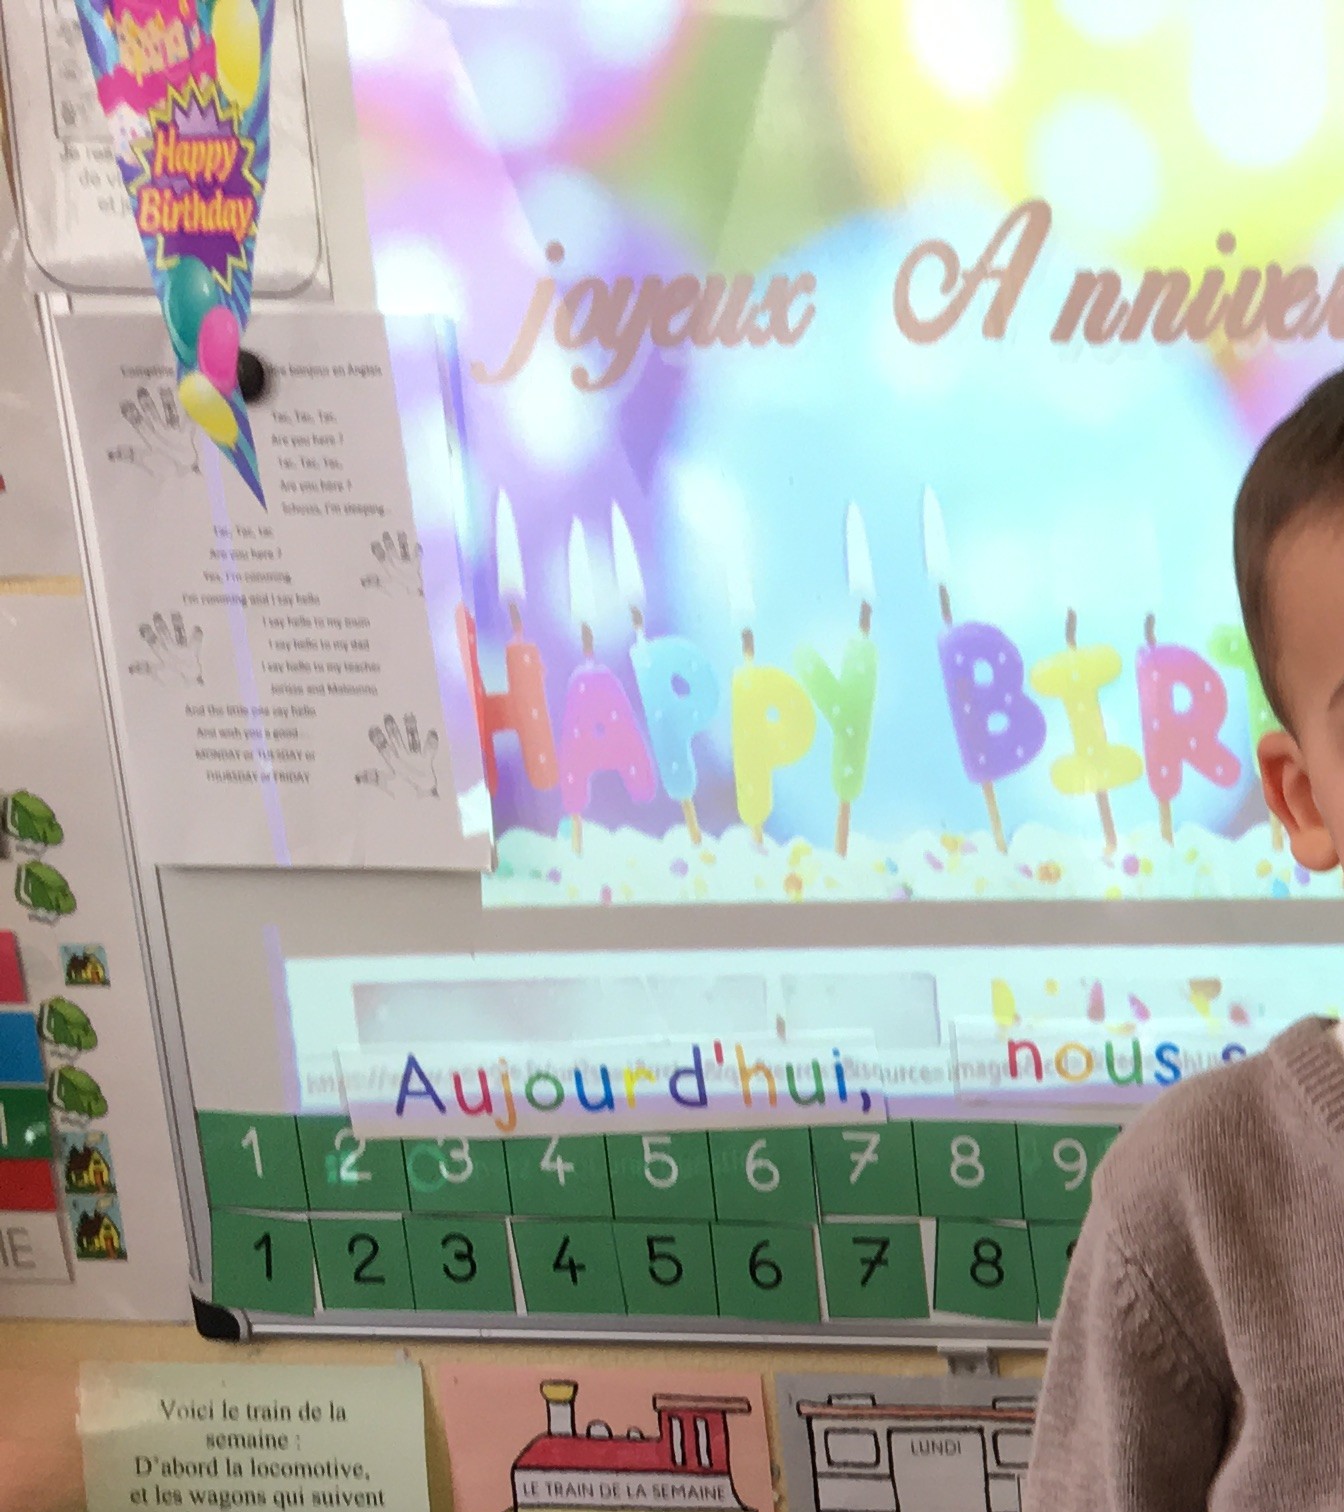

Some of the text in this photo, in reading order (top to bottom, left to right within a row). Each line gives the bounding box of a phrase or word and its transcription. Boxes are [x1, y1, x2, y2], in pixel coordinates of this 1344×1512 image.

[154, 129, 238, 183] Happy
[138, 187, 253, 244] Birthday
[470, 239, 817, 393] joyeux
[396, 1038, 872, 1132] Aujourd'hui,
[1007, 1038, 1184, 1088] nous
[241, 1126, 264, 1178] 1
[438, 1137, 473, 1184] 3
[540, 1136, 574, 1187] 4
[643, 1136, 679, 1190] 5
[745, 1139, 780, 1192] 6
[842, 1132, 881, 1185] 7
[950, 1136, 985, 1188] 8
[1053, 1138, 1088, 1192] 9
[253, 1232, 272, 1281] 1
[347, 1233, 386, 1284] 2
[441, 1233, 477, 1283] 3
[552, 1235, 585, 1286] 4
[646, 1235, 683, 1287] 5
[748, 1240, 783, 1291] 6
[851, 1236, 890, 1289] 7
[970, 1238, 1004, 1290] 8
[160, 1400, 346, 1422] Voici le train de la
[206, 1430, 288, 1450] semaine
[909, 1438, 963, 1457] LUNDI
[135, 1455, 370, 1481] D'abord la locomotive,
[130, 1484, 385, 1512] et les wagons qui suivent
[523, 1481, 725, 1500] LE TRAIN DE LA SEMAINE
